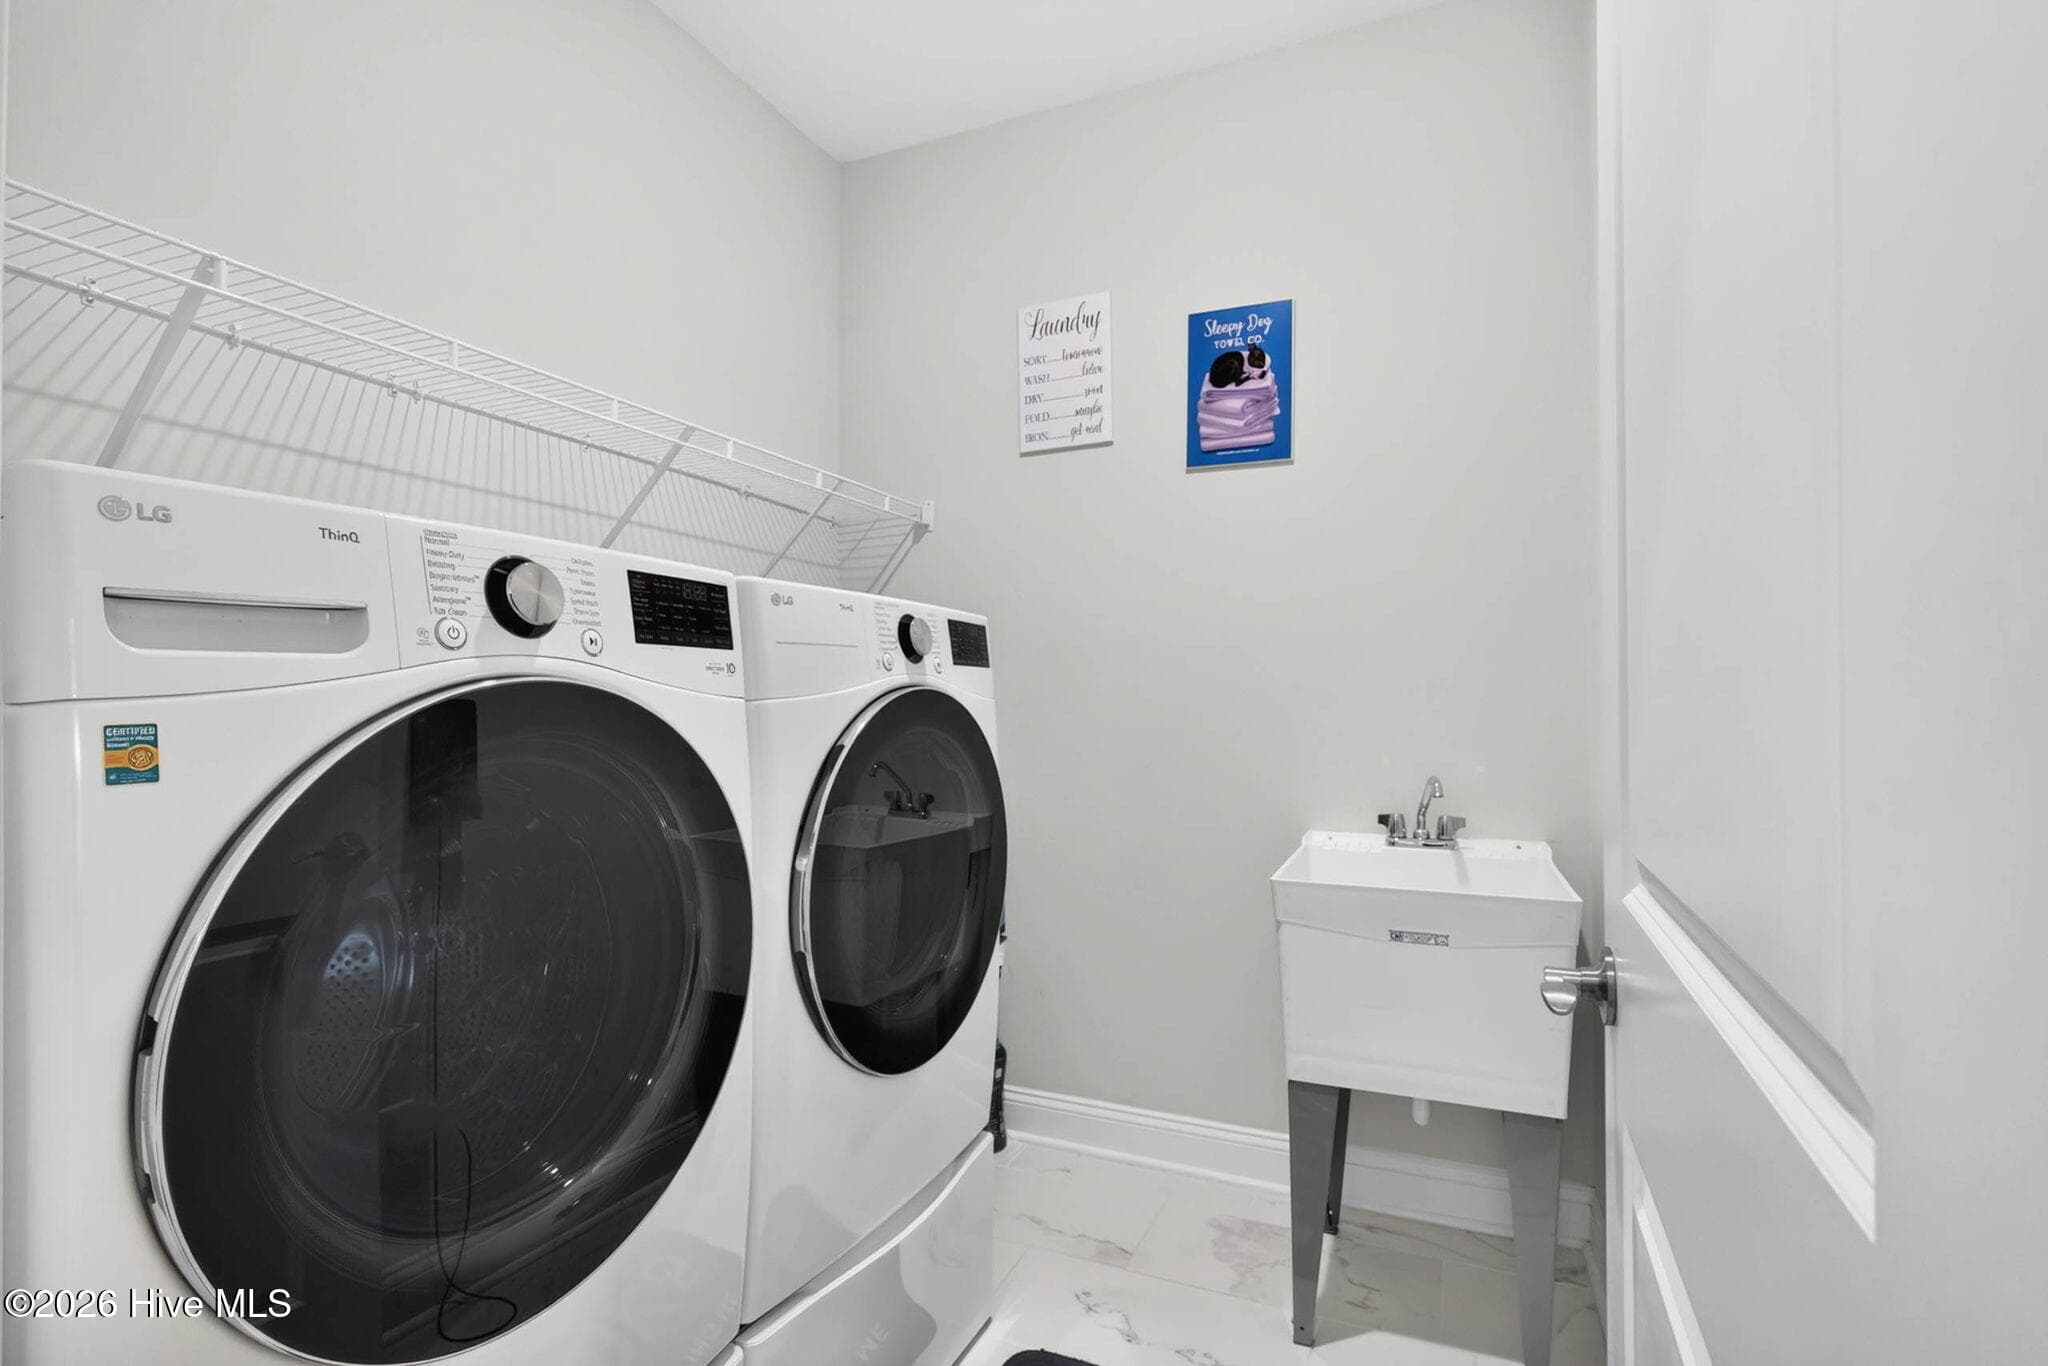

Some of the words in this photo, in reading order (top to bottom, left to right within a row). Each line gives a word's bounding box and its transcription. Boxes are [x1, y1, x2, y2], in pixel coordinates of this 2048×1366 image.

[1024, 300, 1101, 342] Laundry
[1204, 319, 1245, 338] Sleepy
[1247, 313, 1273, 335] Dog
[1214, 337, 1245, 349] TOWEL
[1247, 334, 1265, 345] CO.
[1024, 392, 1044, 405] DRY
[1024, 411, 1050, 425] FOLD
[1024, 431, 1049, 443] IRON
[136, 502, 173, 524] LG
[318, 526, 361, 544] ThinQ
[781, 595, 794, 606] LG
